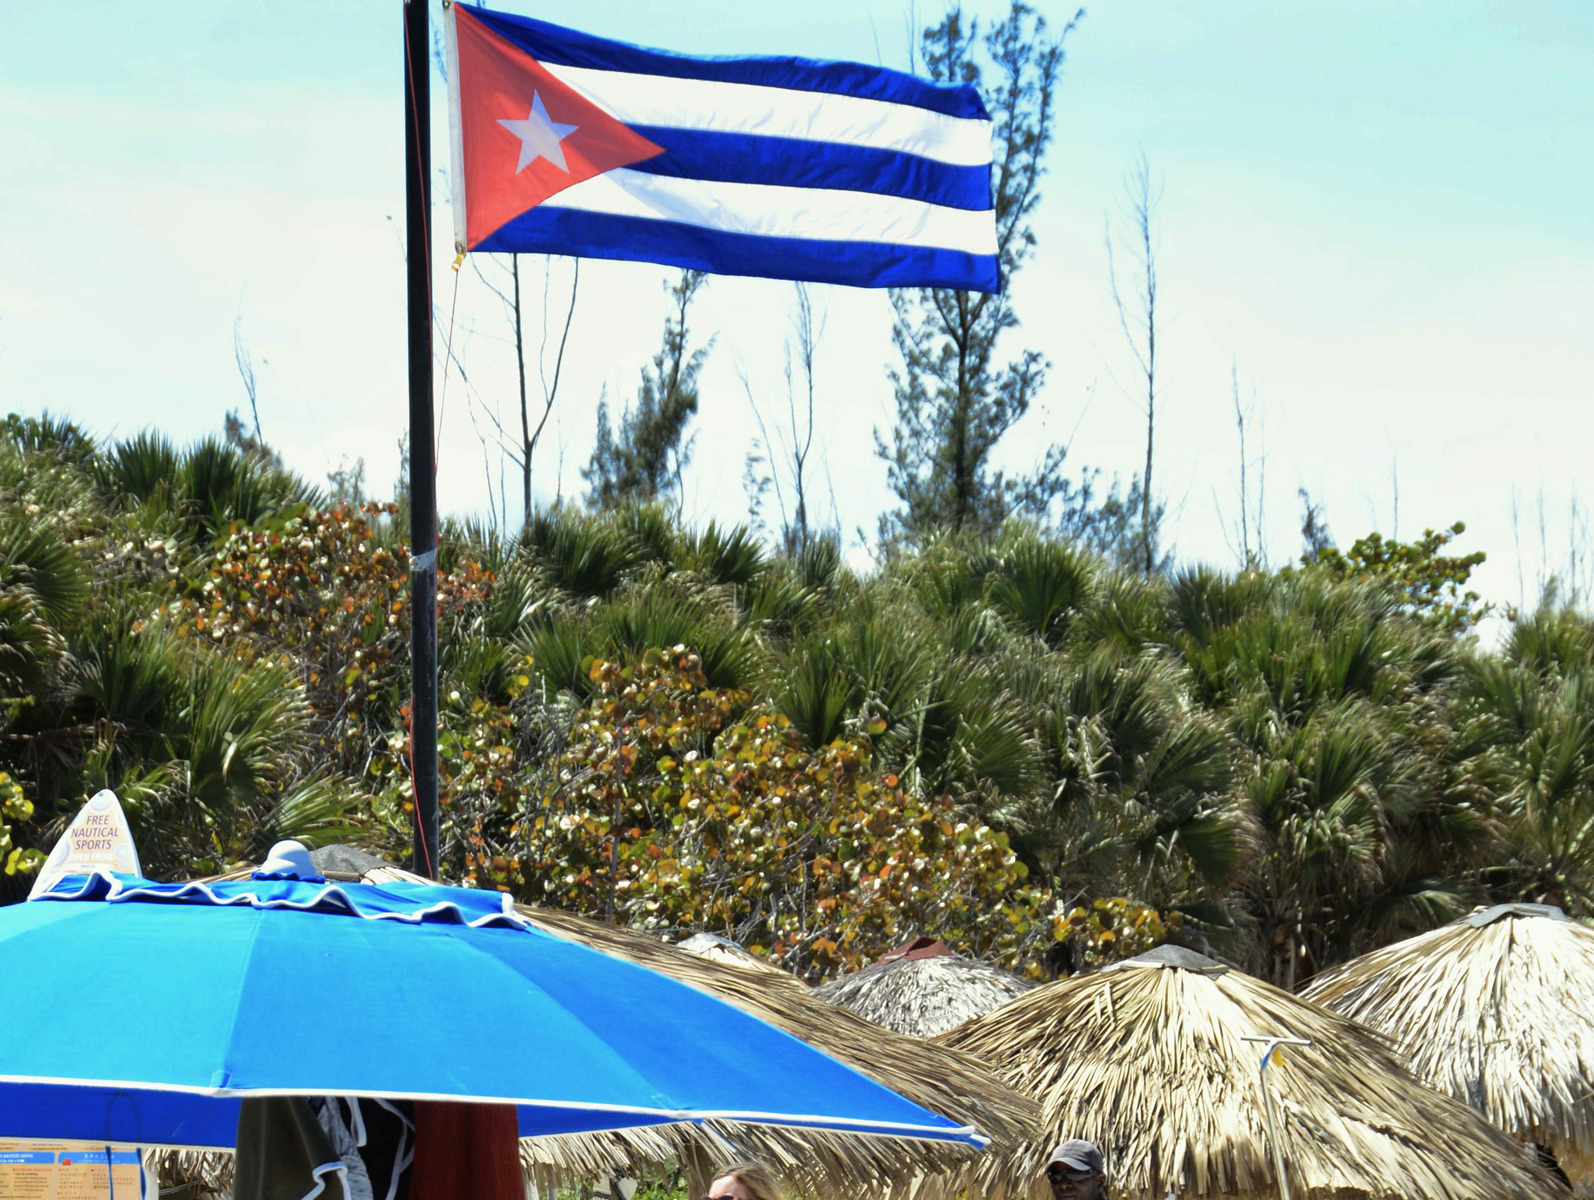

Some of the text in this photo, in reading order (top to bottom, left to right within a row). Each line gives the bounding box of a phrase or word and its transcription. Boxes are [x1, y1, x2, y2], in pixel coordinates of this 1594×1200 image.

[86, 814, 110, 825] FREE
[71, 827, 119, 838] NAUTICAL
[75, 839, 112, 850] SPORTS
